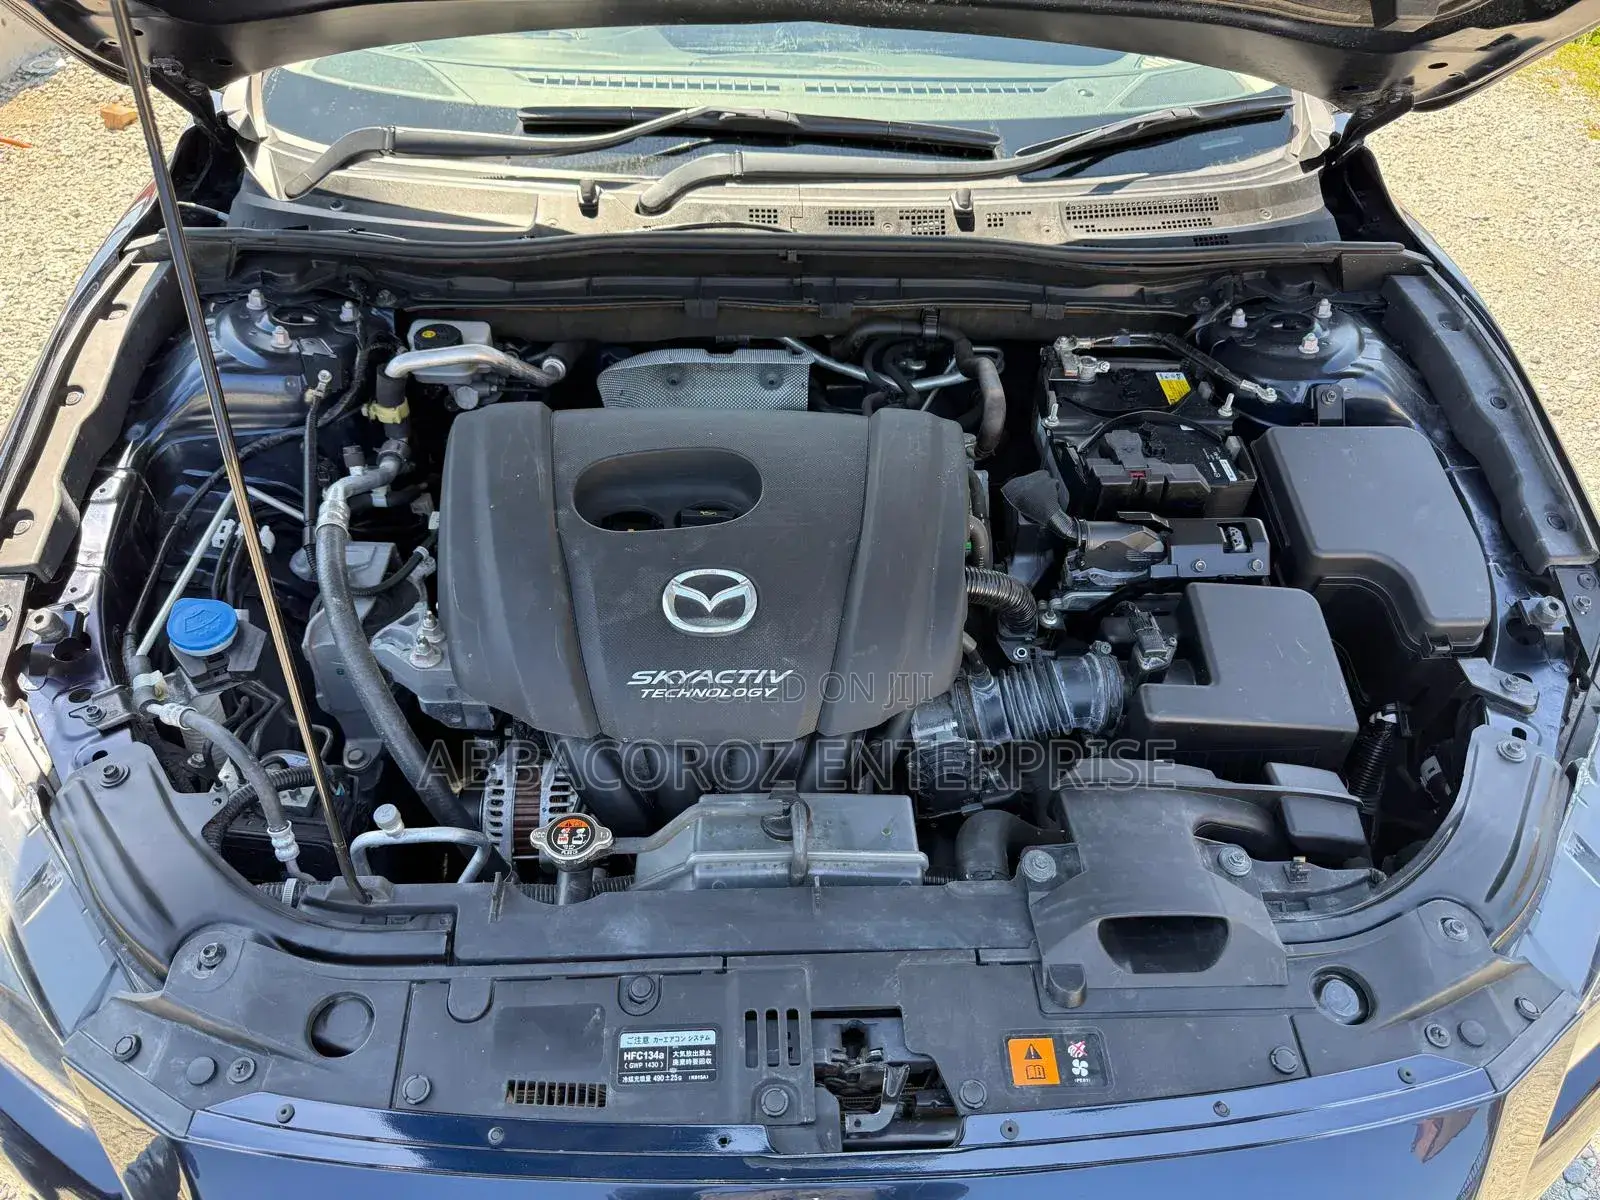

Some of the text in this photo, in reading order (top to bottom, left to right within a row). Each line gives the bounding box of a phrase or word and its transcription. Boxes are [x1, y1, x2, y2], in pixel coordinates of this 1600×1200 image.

[627, 669, 794, 686] SKYACTIV
[640, 687, 779, 699] TECHNOLOGY
[627, 1036, 650, 1045] ご注意
[623, 1050, 665, 1061] HFC134a
